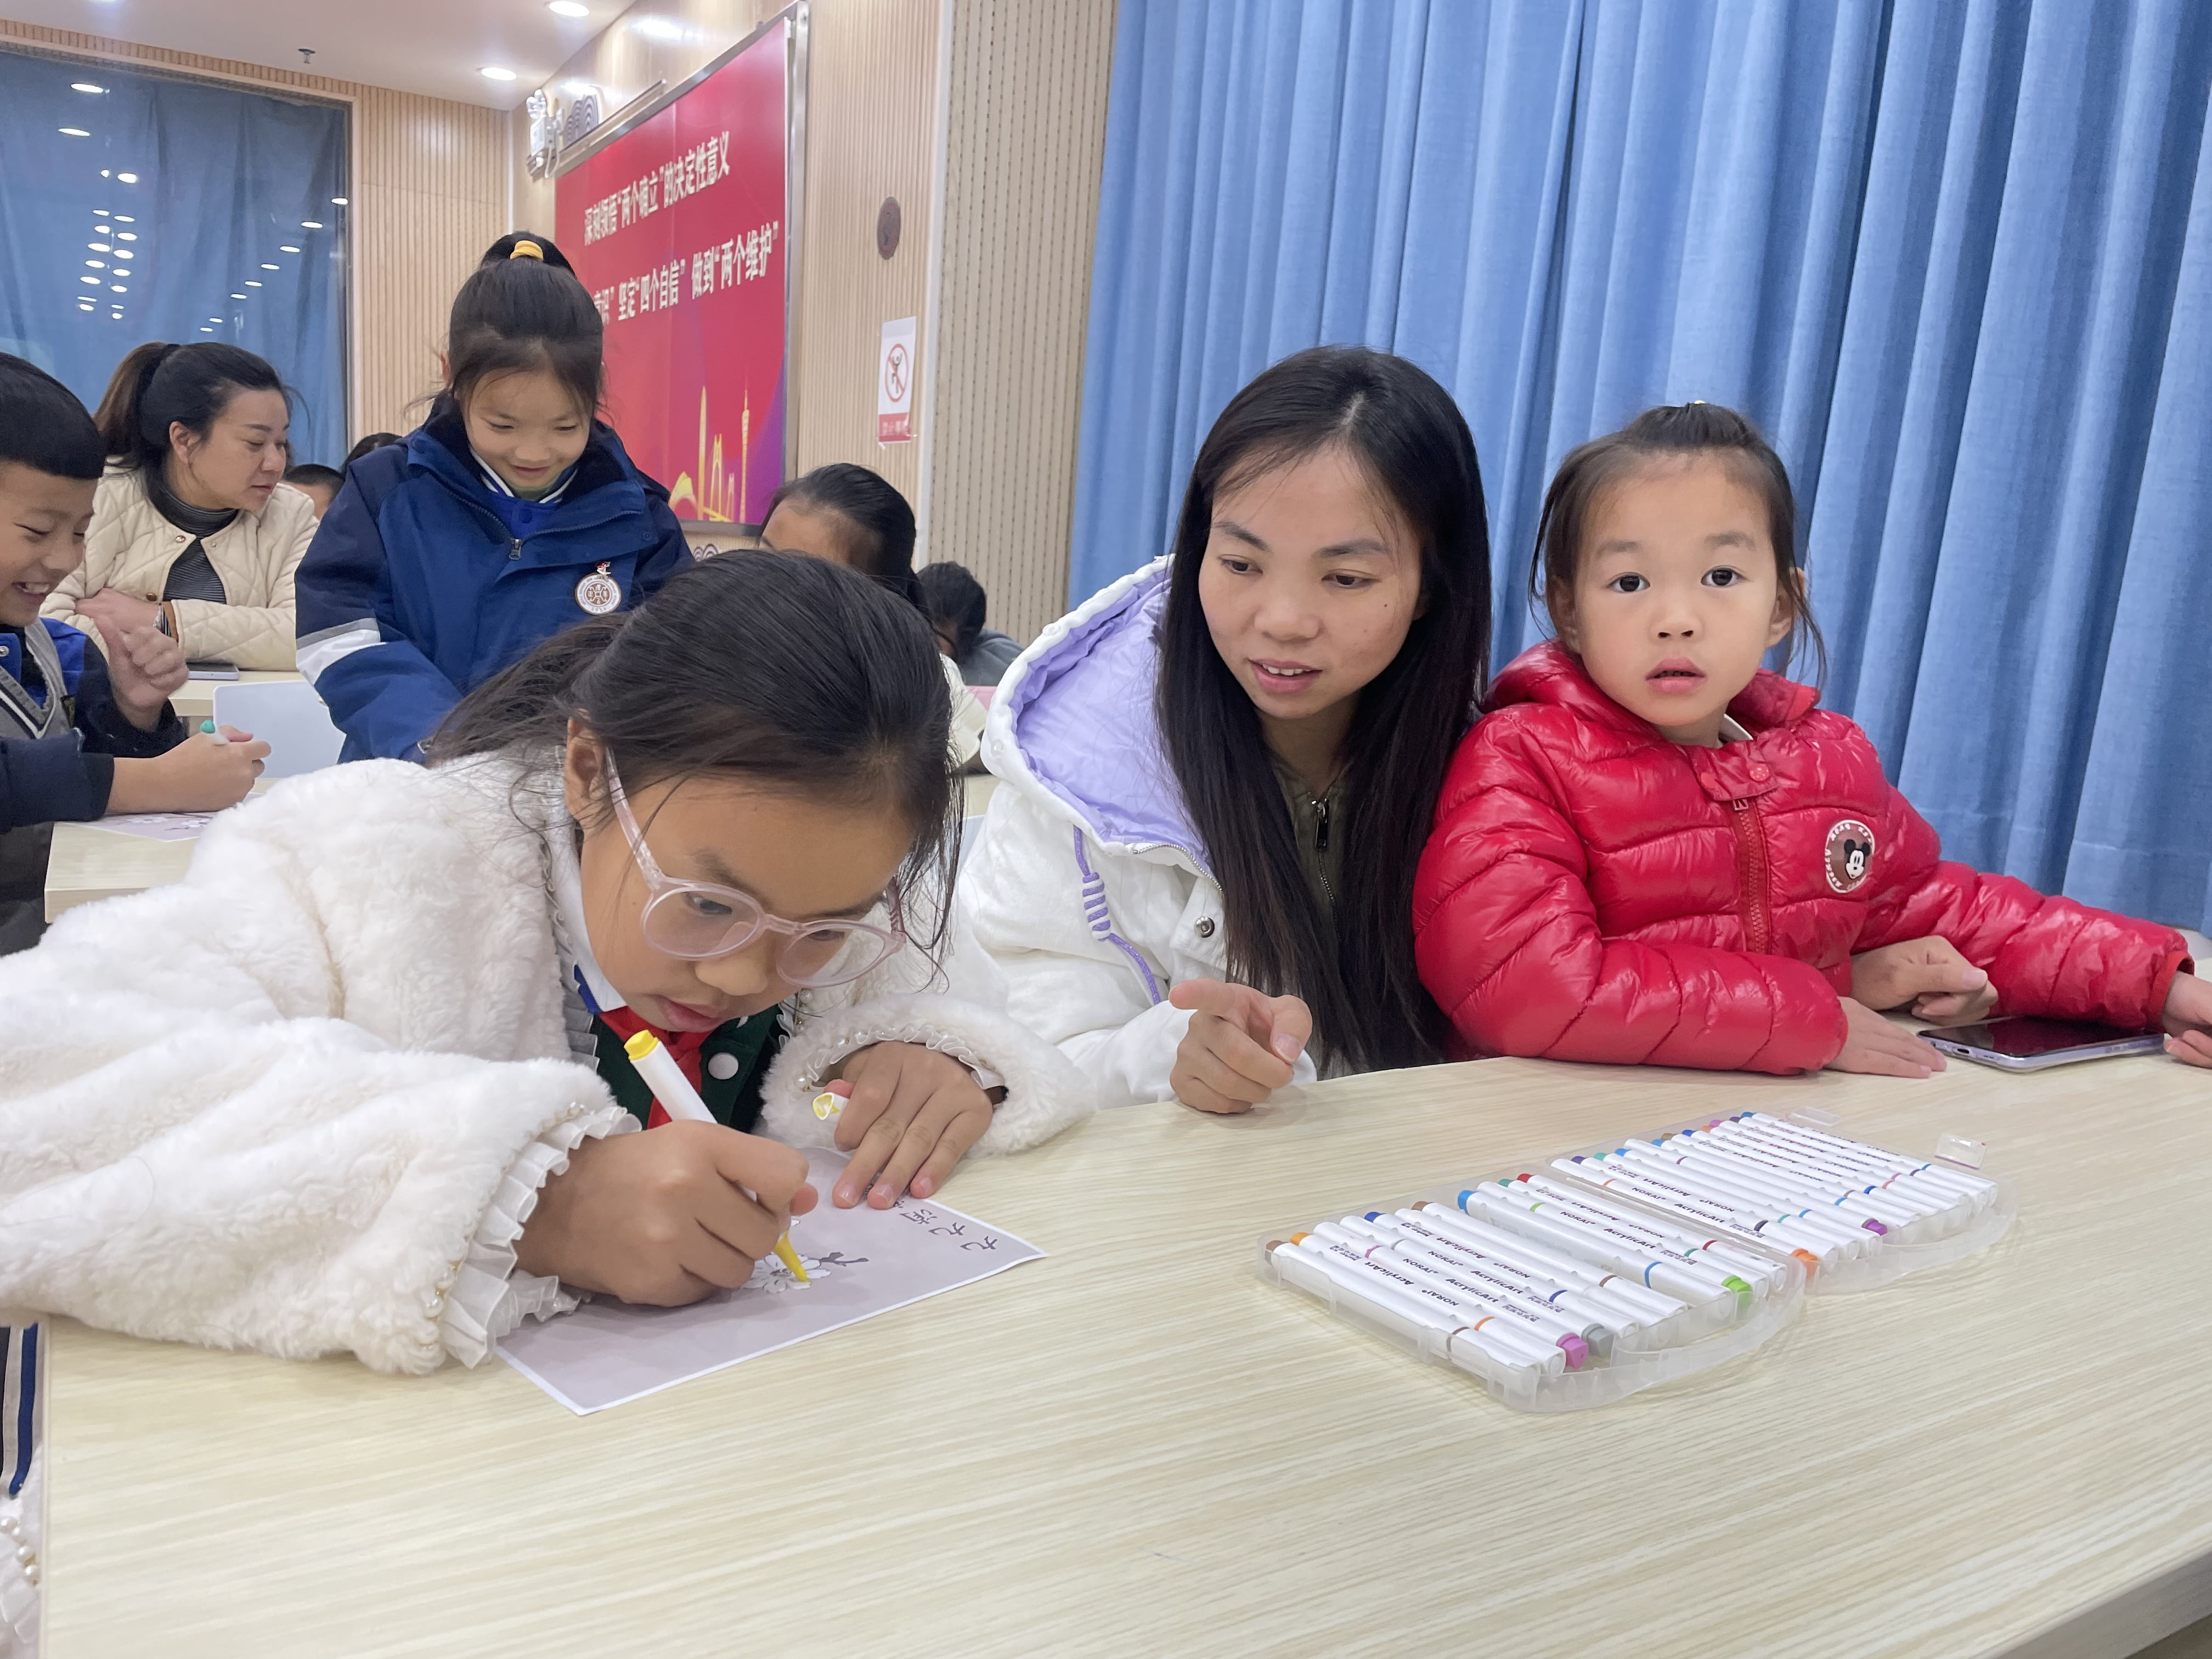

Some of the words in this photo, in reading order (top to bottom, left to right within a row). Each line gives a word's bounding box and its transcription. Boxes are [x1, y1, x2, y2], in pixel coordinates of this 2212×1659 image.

[893, 1200, 998, 1251] 九九消
[1604, 1228, 1656, 1249] AcrylicArt
[1365, 1262, 1415, 1285] AcrylicArt
[1471, 1271, 1523, 1294] AcrylicArt
[1446, 1278, 1498, 1303] AcrylicArt
